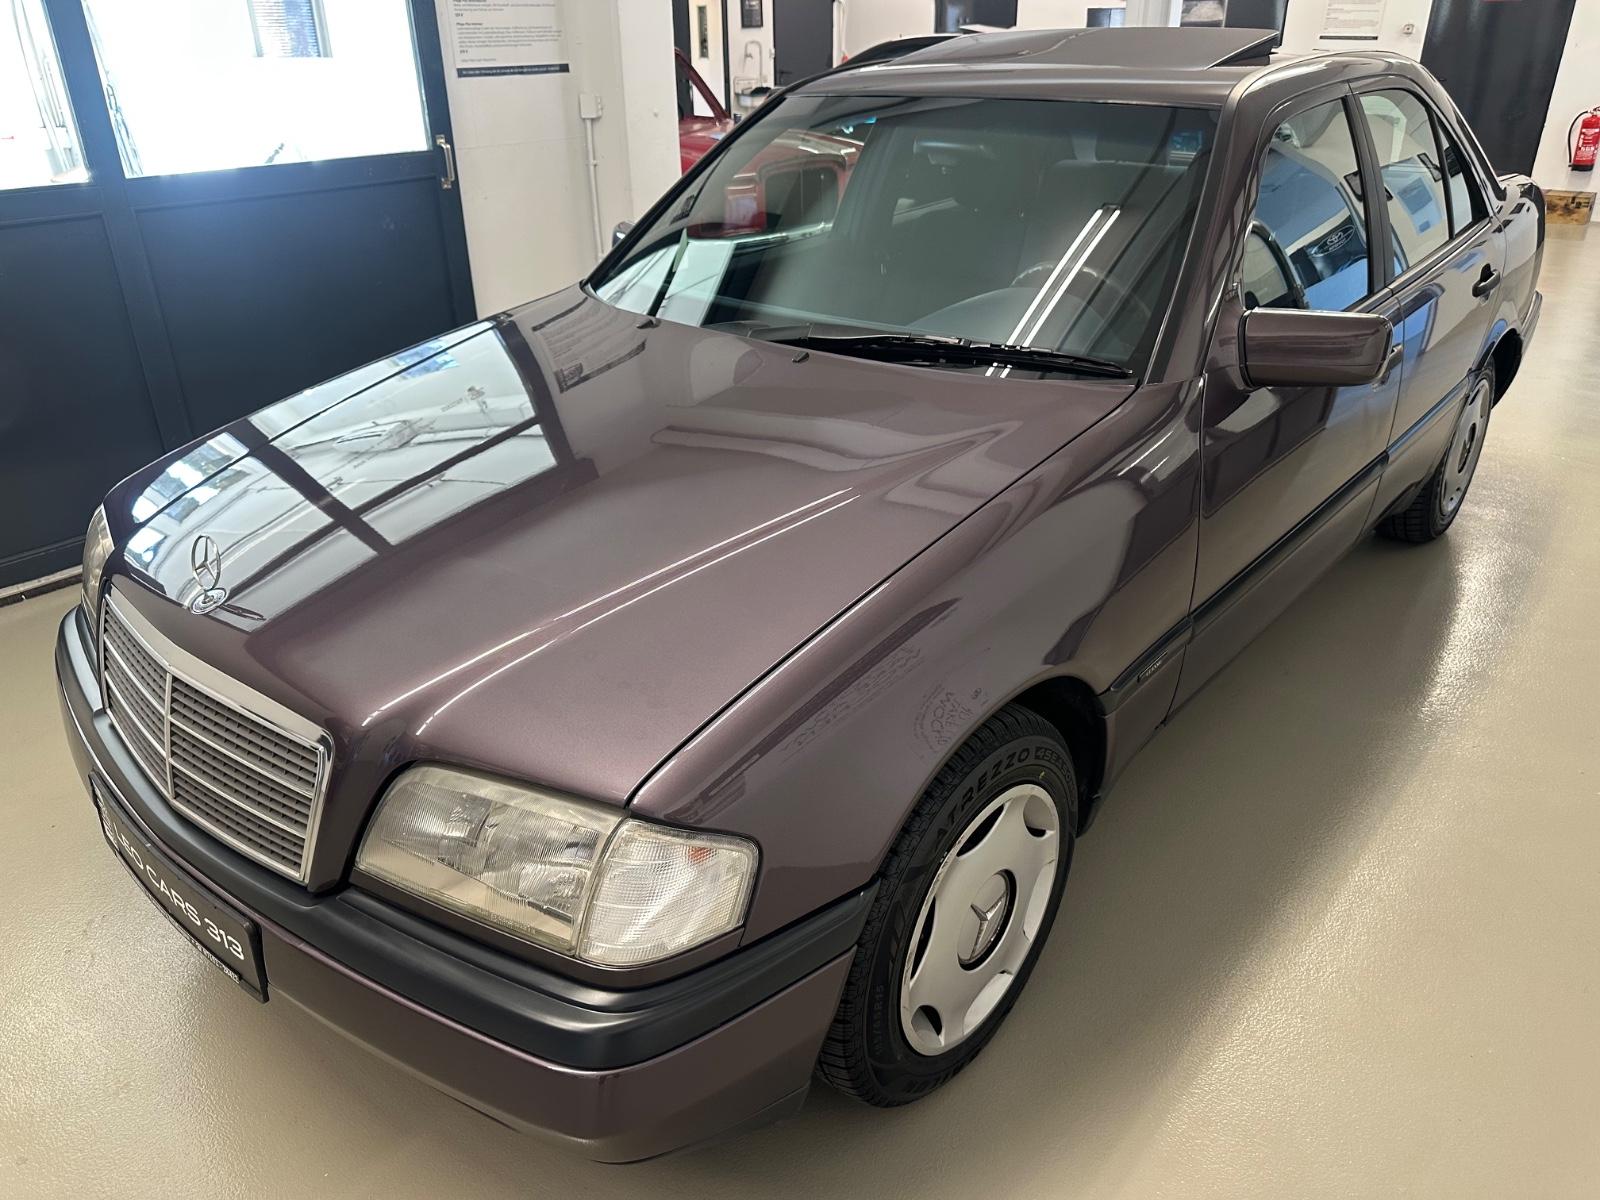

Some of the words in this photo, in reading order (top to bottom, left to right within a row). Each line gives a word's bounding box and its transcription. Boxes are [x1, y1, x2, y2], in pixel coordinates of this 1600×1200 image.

[113, 821, 144, 870] LEO
[146, 864, 202, 926] CARS
[203, 917, 245, 961] 313
